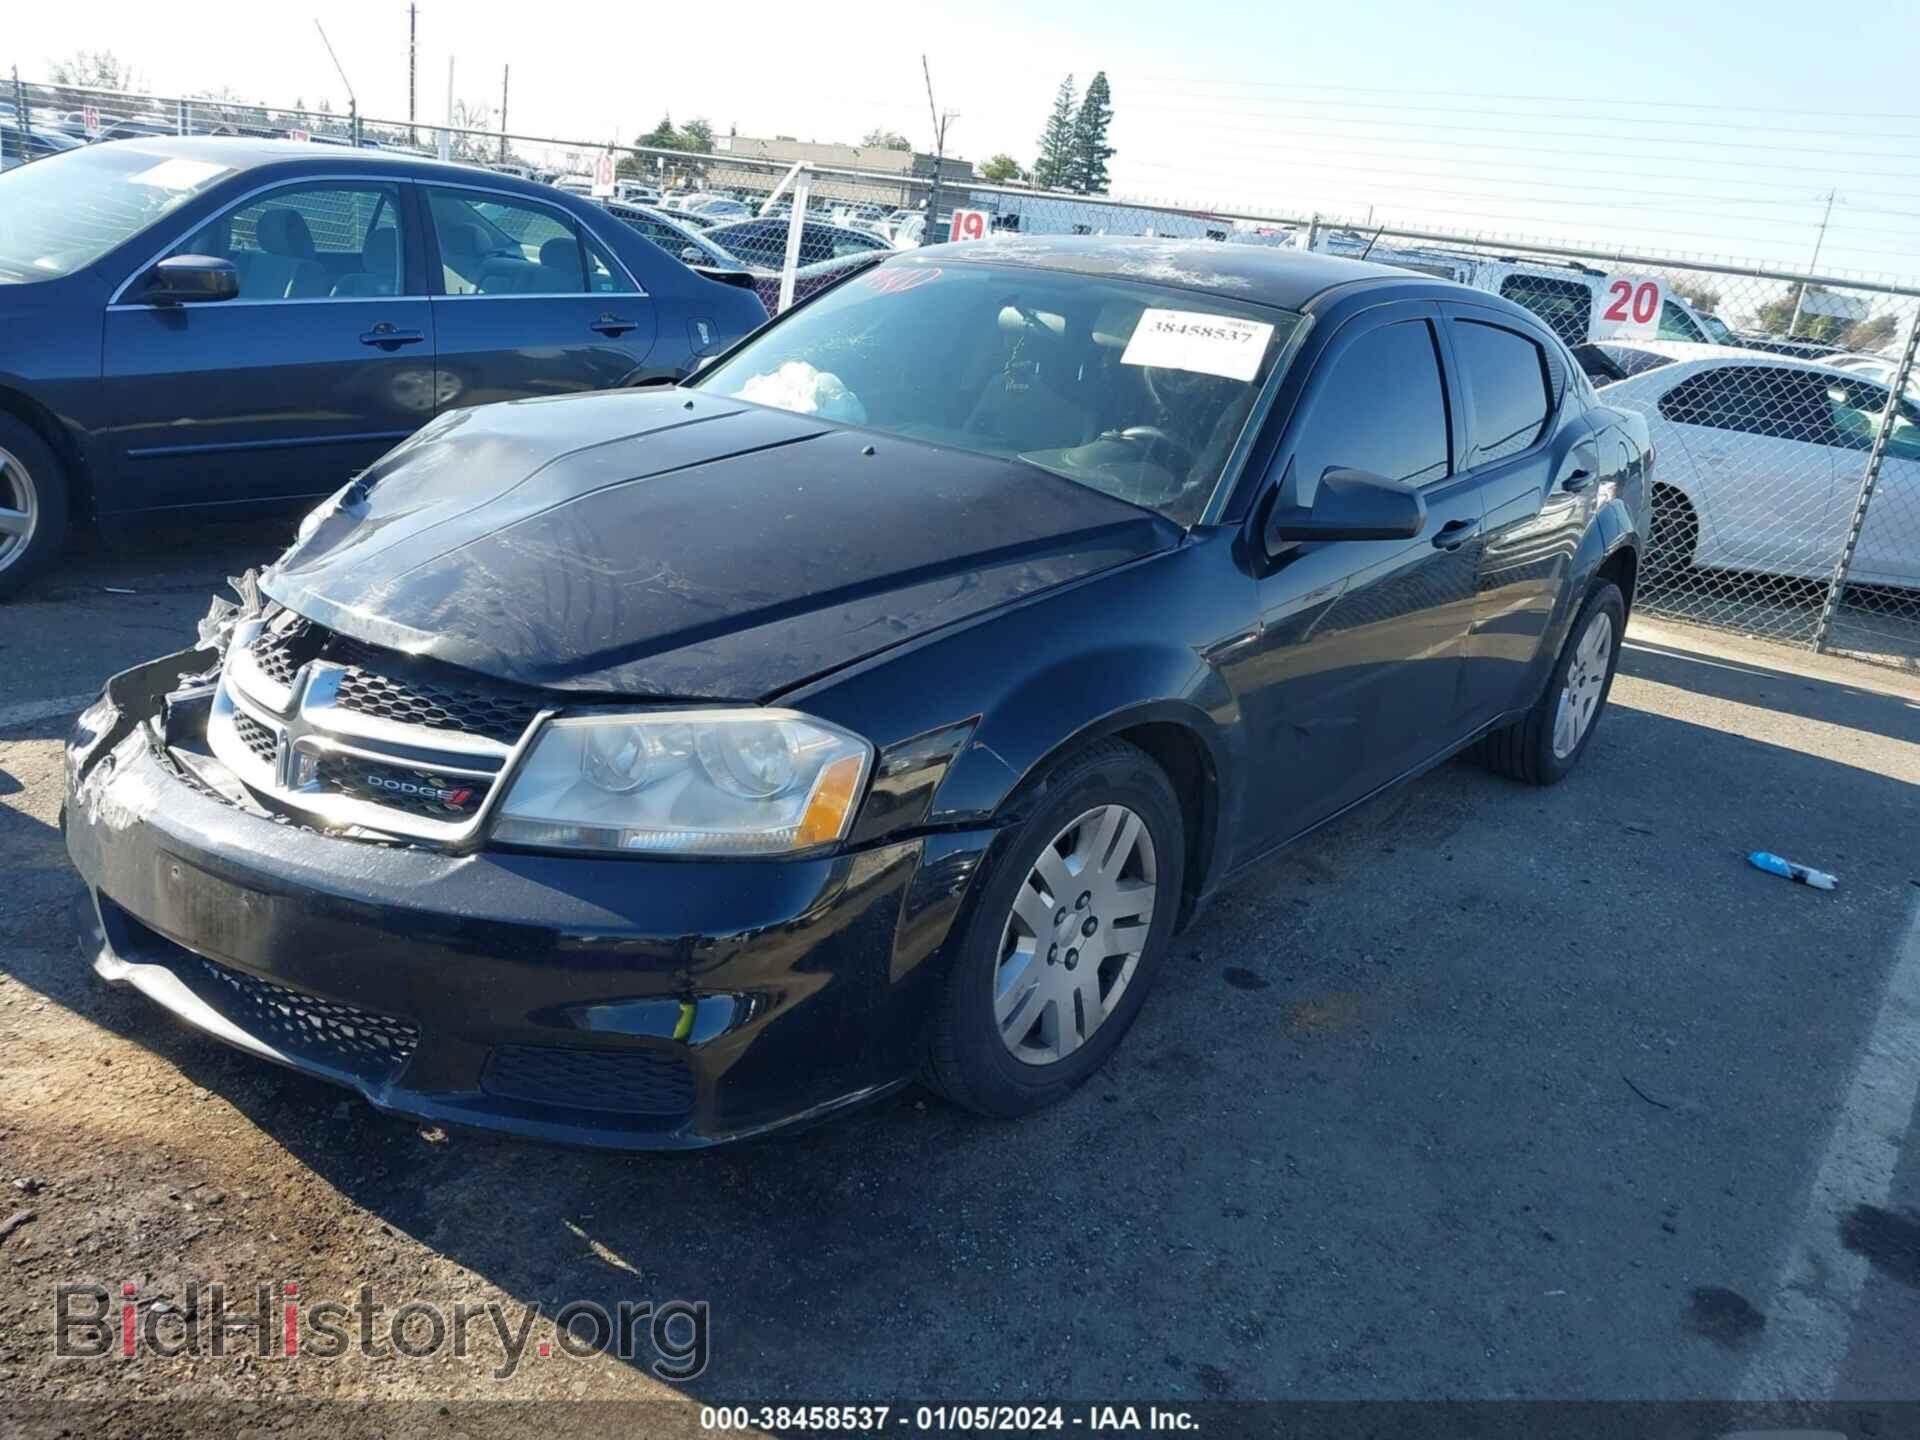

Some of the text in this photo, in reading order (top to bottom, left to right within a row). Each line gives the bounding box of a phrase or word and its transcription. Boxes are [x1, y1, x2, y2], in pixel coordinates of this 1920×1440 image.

[951, 212, 984, 241] 19
[1603, 280, 1659, 324] 20
[1150, 320, 1253, 345] 38458537
[367, 775, 457, 802] DODGE
